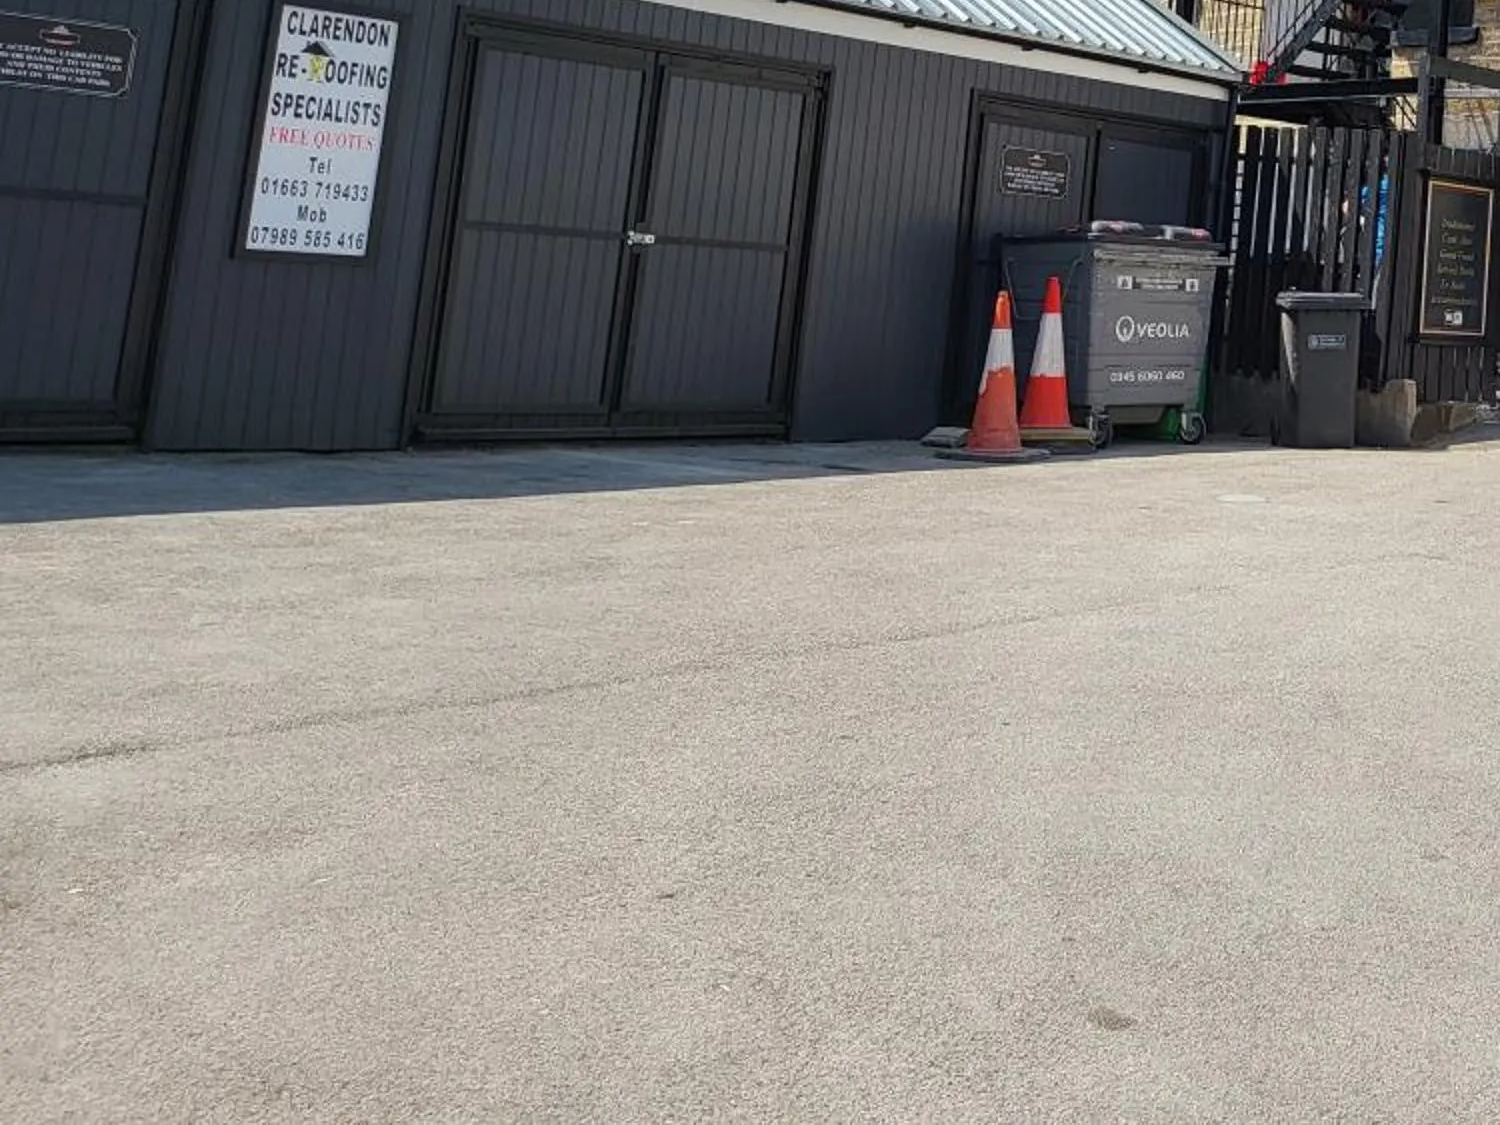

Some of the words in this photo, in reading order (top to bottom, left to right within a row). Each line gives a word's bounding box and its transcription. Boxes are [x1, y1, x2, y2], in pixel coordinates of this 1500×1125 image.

[287, 11, 391, 47] CLARENDON
[271, 92, 382, 126] SPECIALISTS
[270, 126, 309, 146] FREE
[314, 131, 375, 151] QUOTES
[309, 156, 332, 174] Tel
[261, 177, 308, 197] 01663
[315, 181, 369, 202] 719433
[297, 205, 327, 223] Mob
[251, 226, 297, 246] 07989
[304, 230, 331, 248] 585
[337, 232, 365, 250] 416
[1137, 322, 1190, 338] VEOLIA
